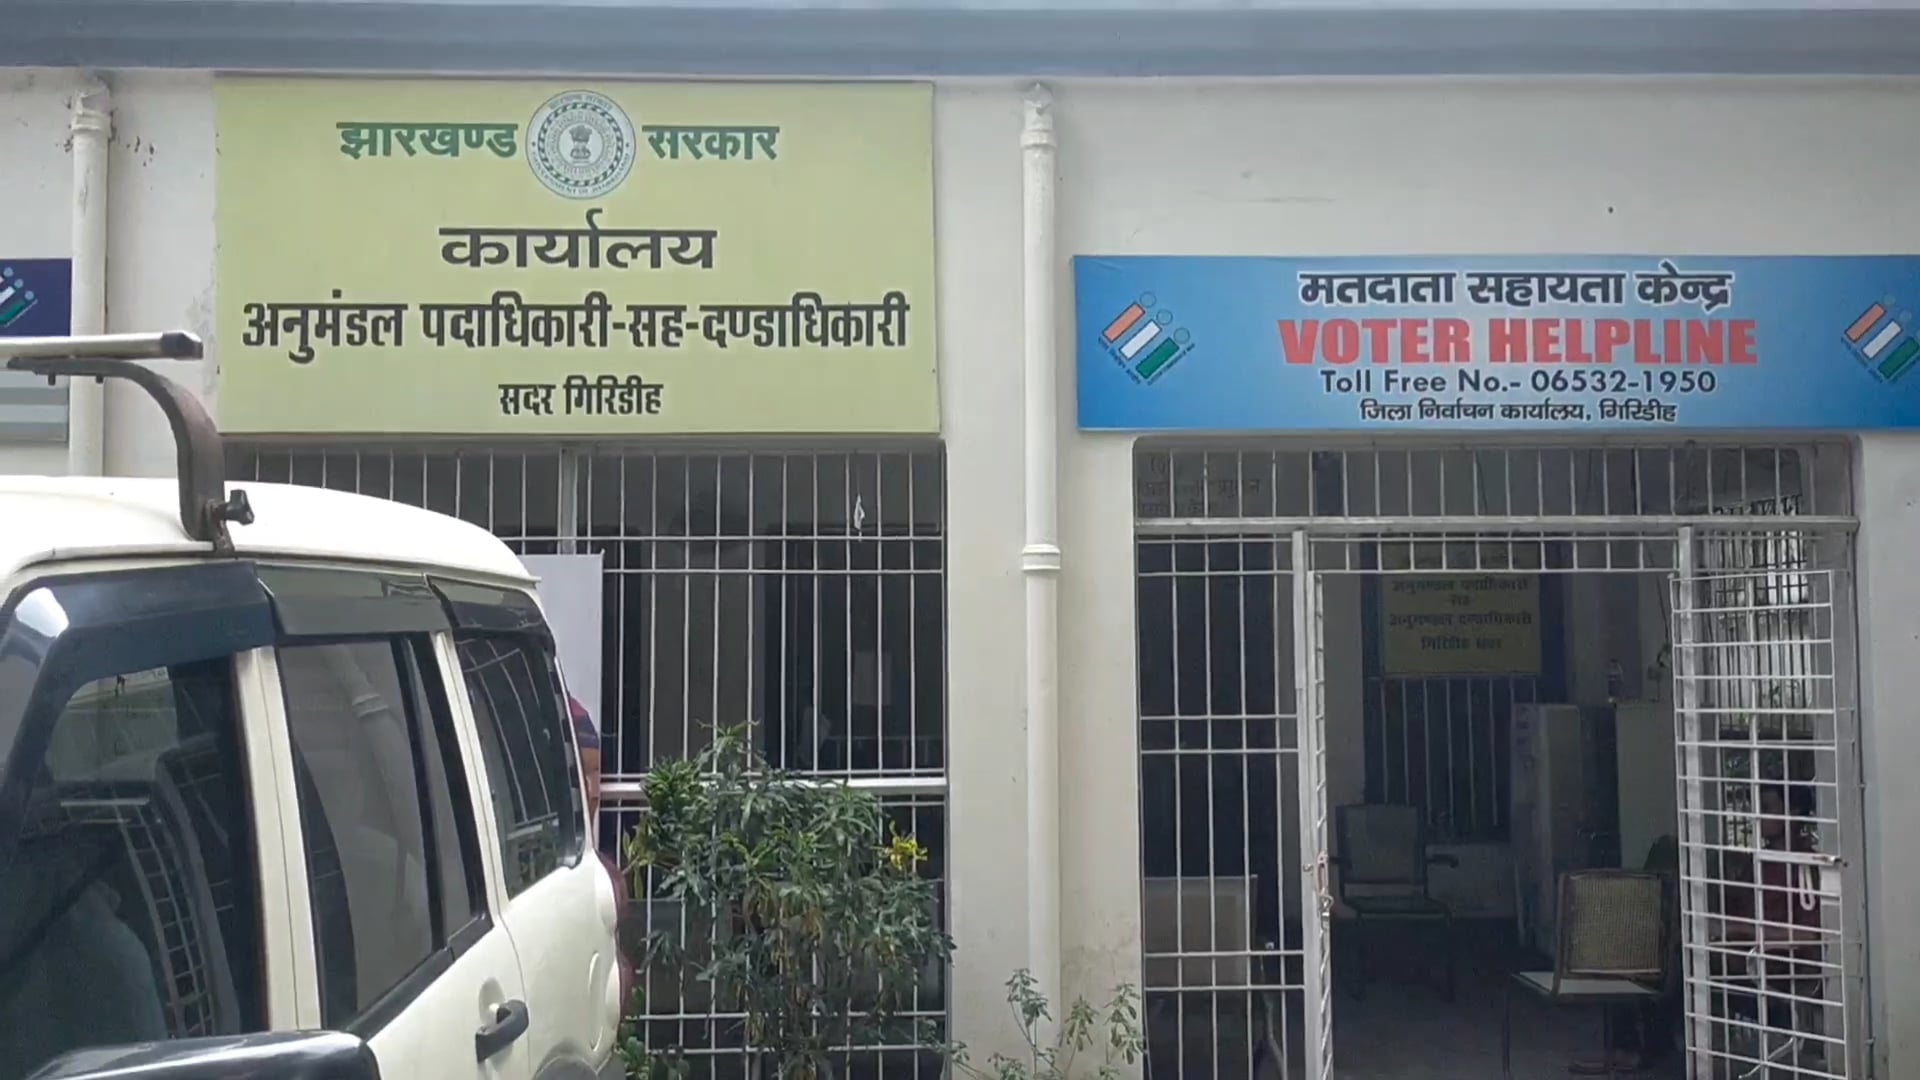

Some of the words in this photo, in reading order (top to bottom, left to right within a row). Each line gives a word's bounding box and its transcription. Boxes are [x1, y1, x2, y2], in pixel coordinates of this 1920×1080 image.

[336, 122, 519, 159] झारखण्ड
[641, 125, 781, 160] सरकार
[438, 208, 718, 269] कार्यालय
[1298, 272, 1455, 304] मतदाता
[1465, 272, 1626, 307] सहायता
[1635, 259, 1735, 311] केन्द्र
[242, 288, 409, 364] अनुमंडल
[419, 290, 911, 349] पदाधिकारी-सह-दण्डाधिकारी
[1278, 319, 1471, 365] VOTER
[1489, 318, 1757, 365] HELPLINE
[498, 384, 556, 416] सदर
[562, 374, 664, 415] गिरिडीह
[1321, 370, 1371, 393] Toll
[1384, 370, 1446, 393] Free
[1458, 370, 1521, 393] No.-
[1531, 369, 1717, 393] 06532-1950
[1359, 399, 1411, 422] जिला
[1418, 398, 1494, 421] निर्वाचन
[1598, 399, 1677, 422] गिरिडीह
